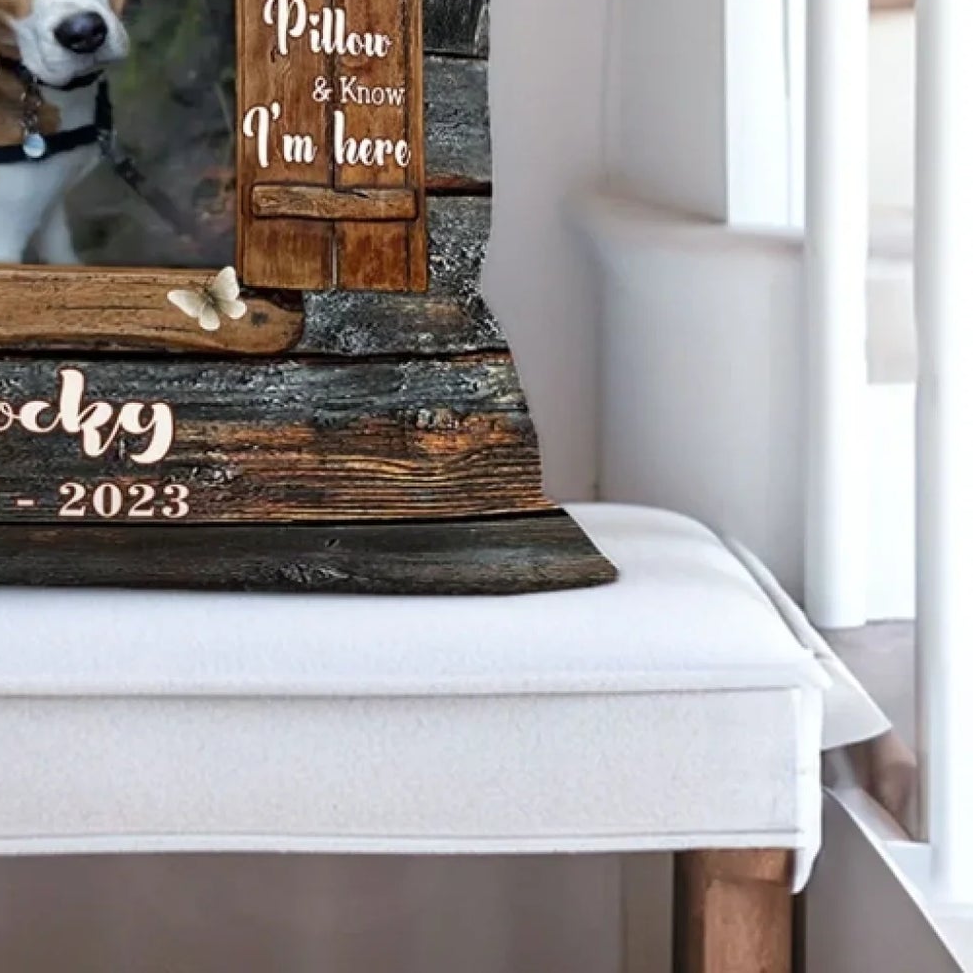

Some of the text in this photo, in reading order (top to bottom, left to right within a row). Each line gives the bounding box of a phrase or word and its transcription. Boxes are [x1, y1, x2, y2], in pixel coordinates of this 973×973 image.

[312, 76, 406, 106] & Know
[243, 102, 411, 168] I'm here
[16, 498, 35, 507] -
[59, 482, 190, 518] 2023
